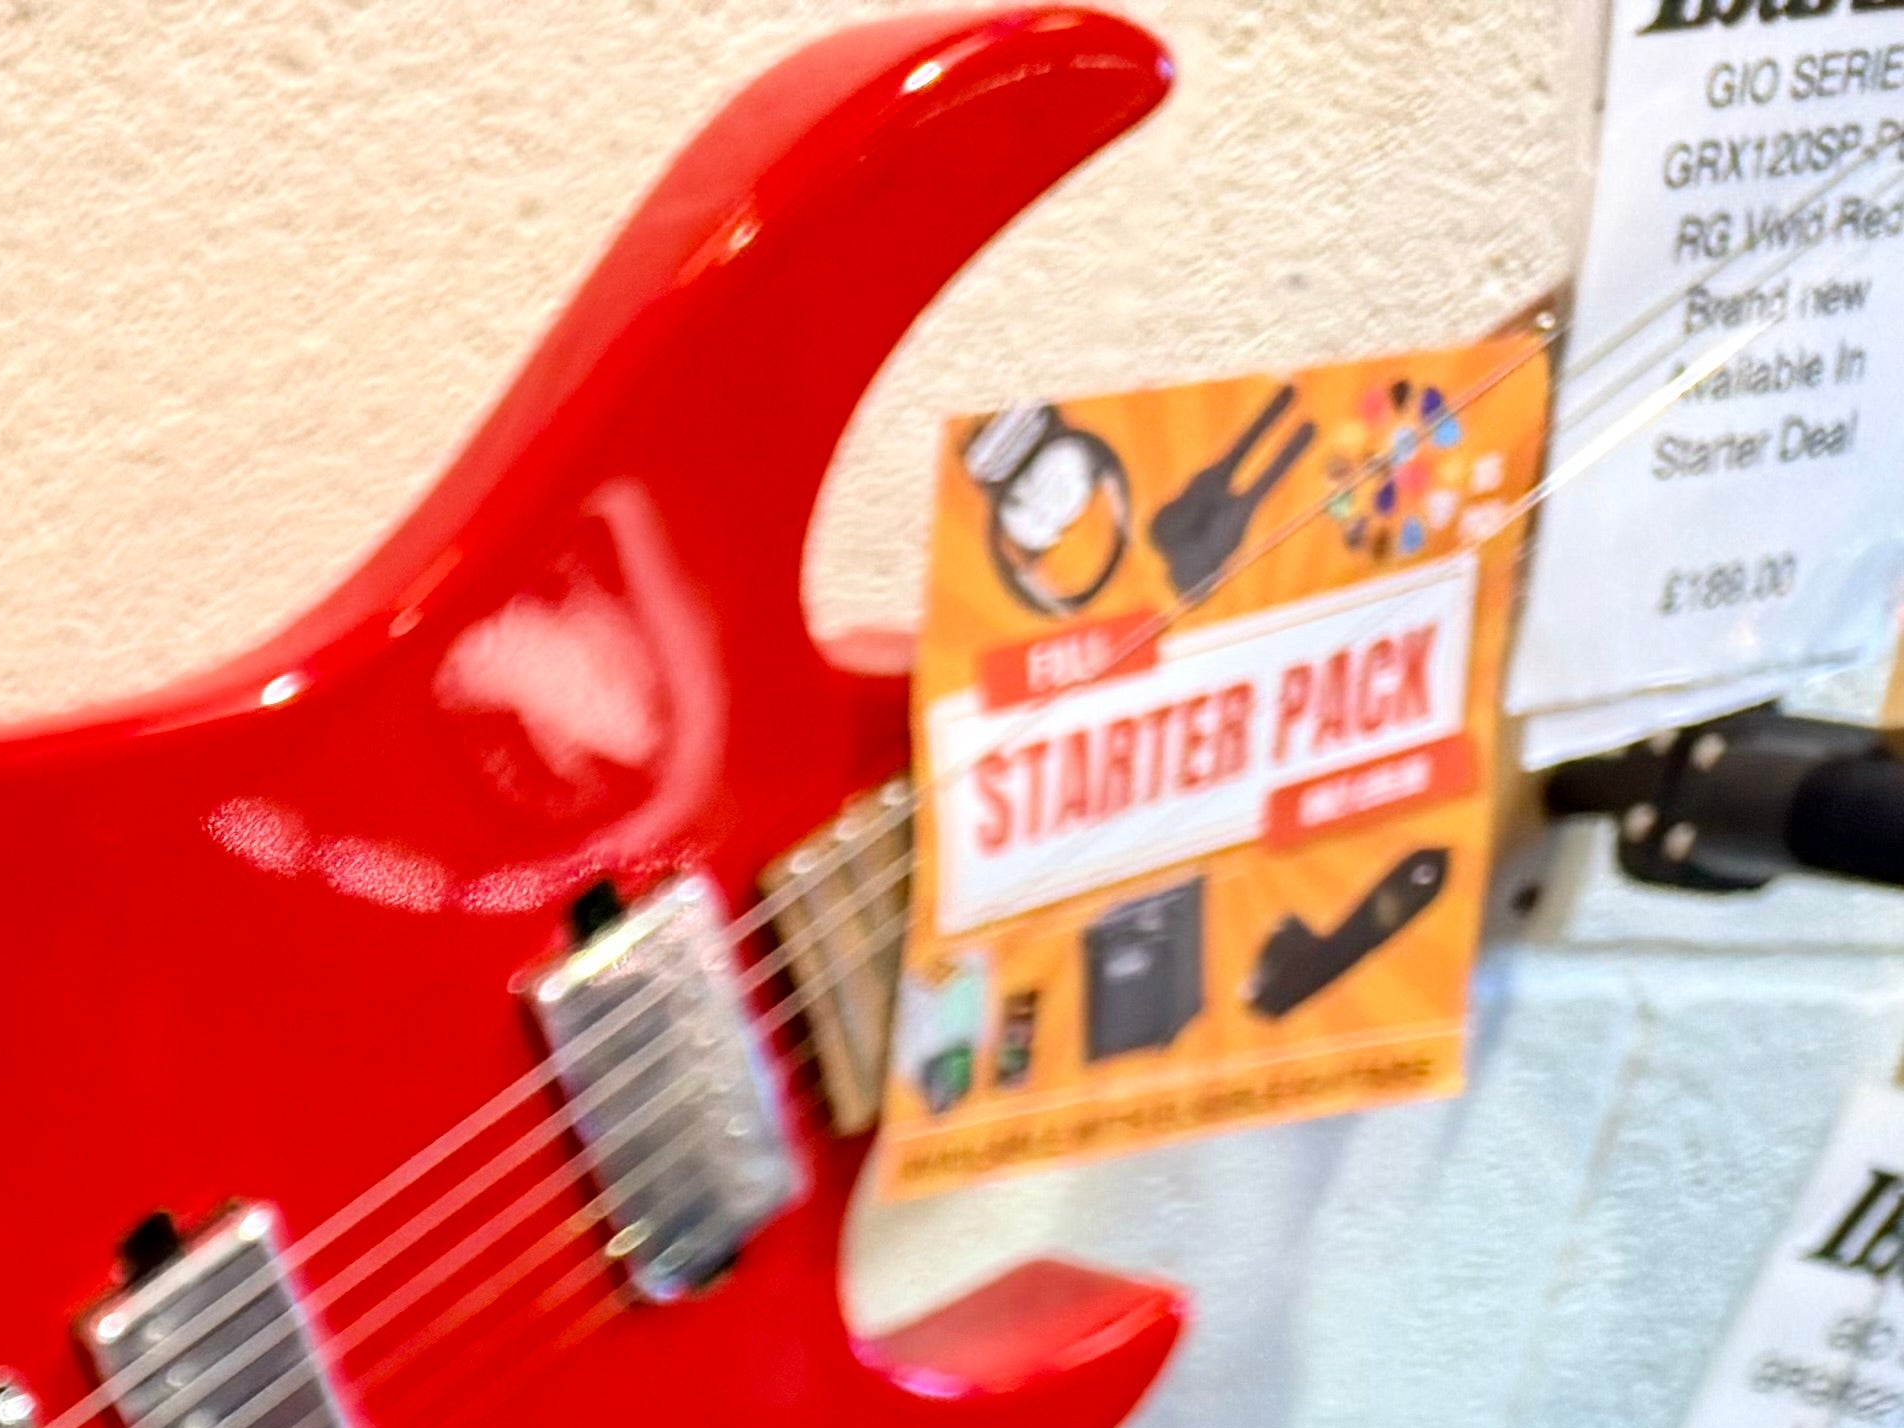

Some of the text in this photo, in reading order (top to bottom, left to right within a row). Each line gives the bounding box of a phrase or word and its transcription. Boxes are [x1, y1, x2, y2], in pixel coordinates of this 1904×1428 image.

[1706, 56, 1779, 109] GIO
[1673, 211, 1732, 263] RG
[1780, 409, 1859, 463] Deal
[972, 678, 1253, 856] STARTER
[1272, 624, 1437, 766] PACK
